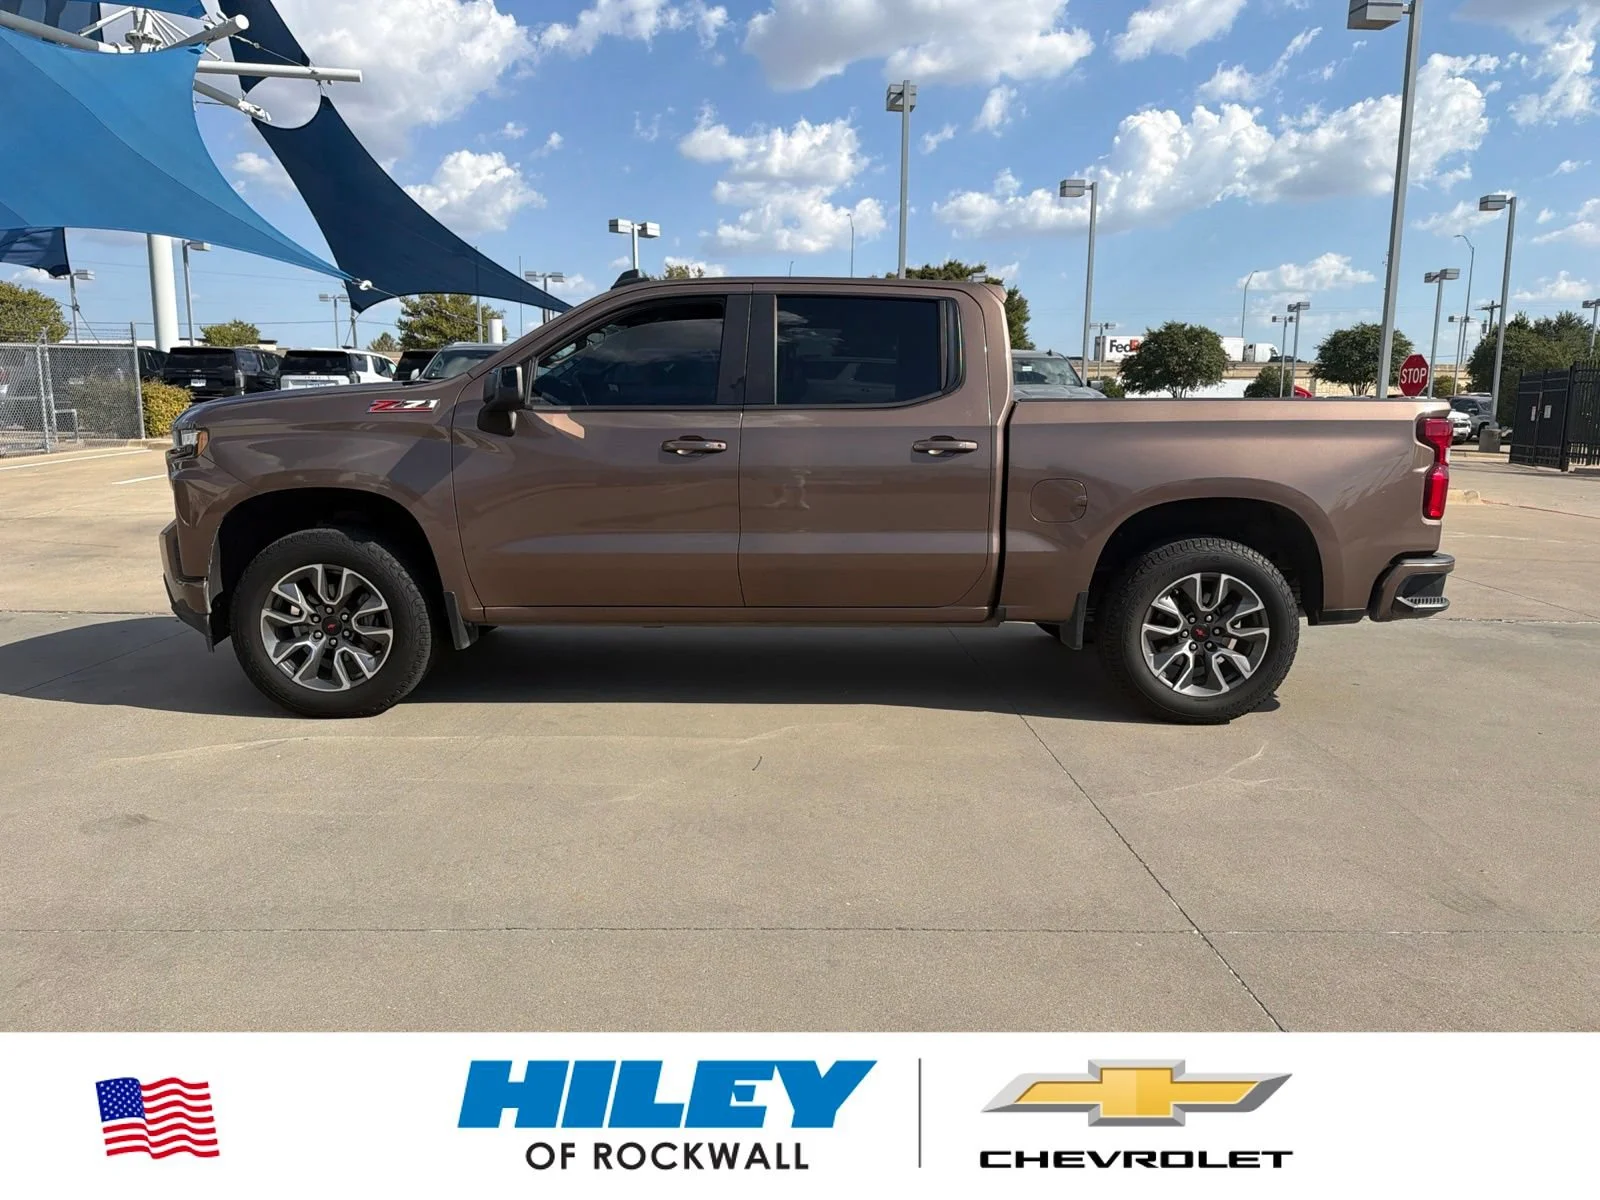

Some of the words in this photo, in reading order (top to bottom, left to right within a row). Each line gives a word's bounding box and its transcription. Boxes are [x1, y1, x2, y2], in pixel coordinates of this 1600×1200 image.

[1109, 339, 1140, 353] FedE
[1400, 367, 1427, 384] STOP
[367, 398, 440, 413] Z71
